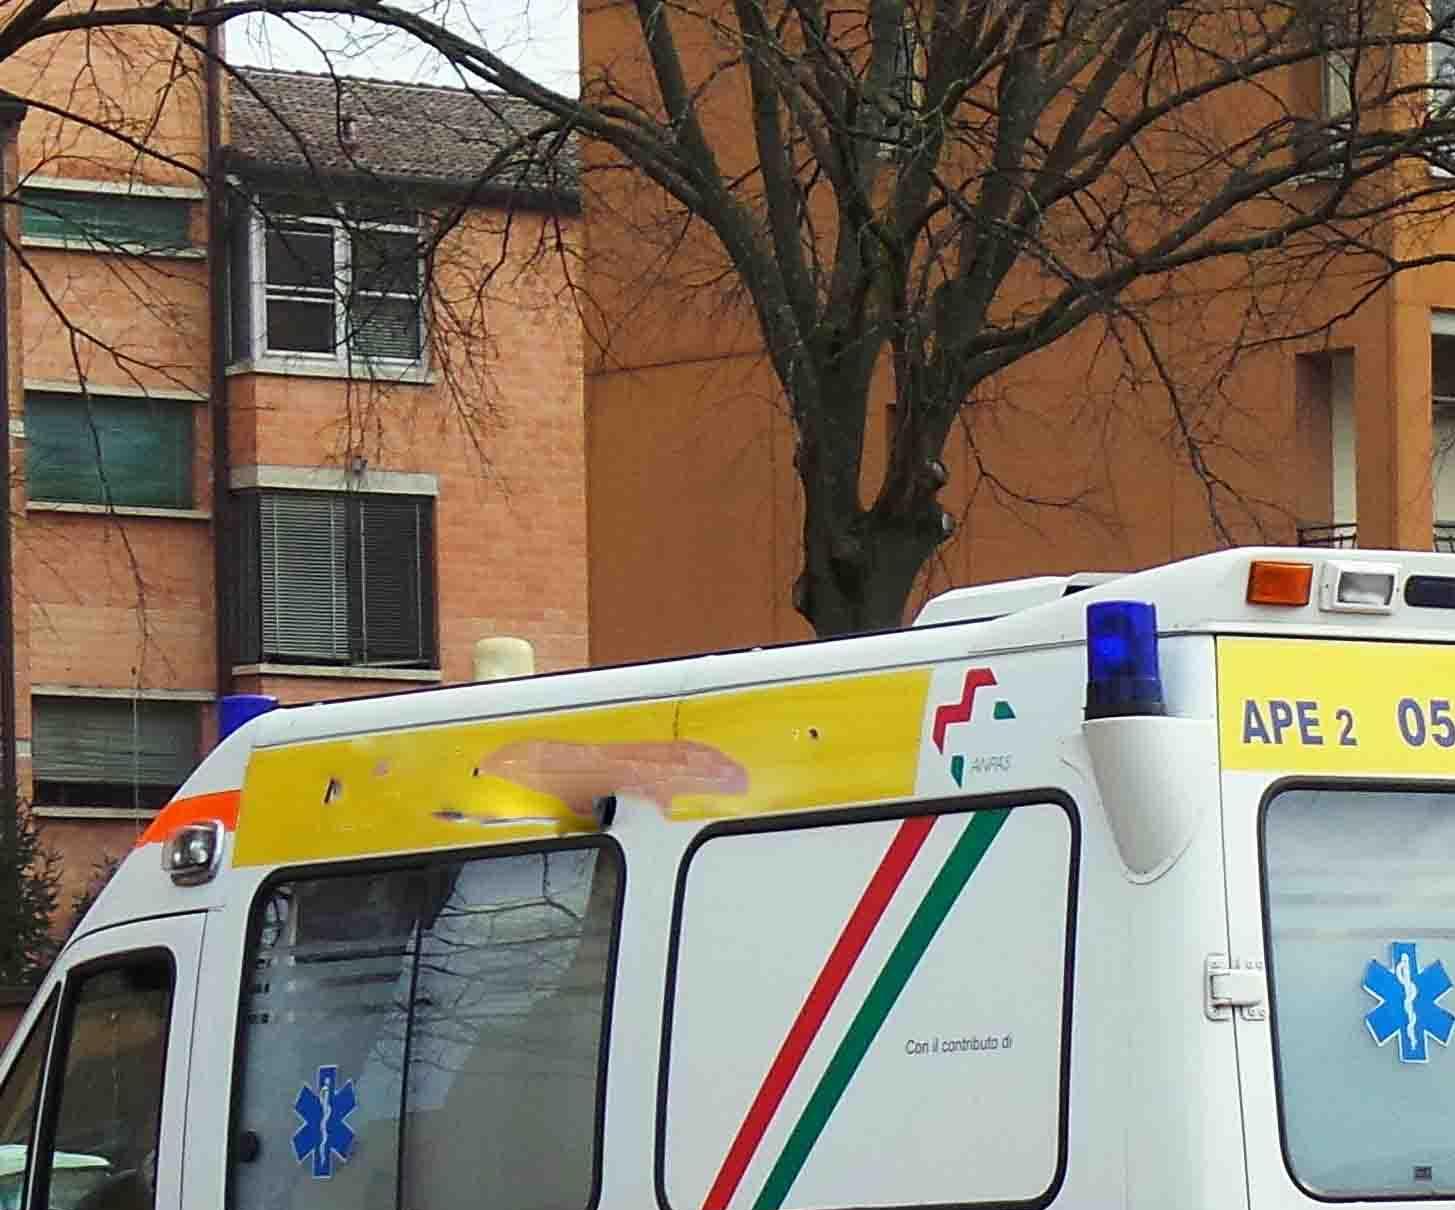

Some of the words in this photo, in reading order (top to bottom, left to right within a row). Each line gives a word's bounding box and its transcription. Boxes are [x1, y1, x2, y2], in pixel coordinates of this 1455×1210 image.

[1242, 700, 1324, 746] APE
[1335, 708, 1358, 747] 2
[905, 1038, 929, 1055] Con
[941, 1034, 999, 1054] contributo
[1001, 1031, 1014, 1049] di
